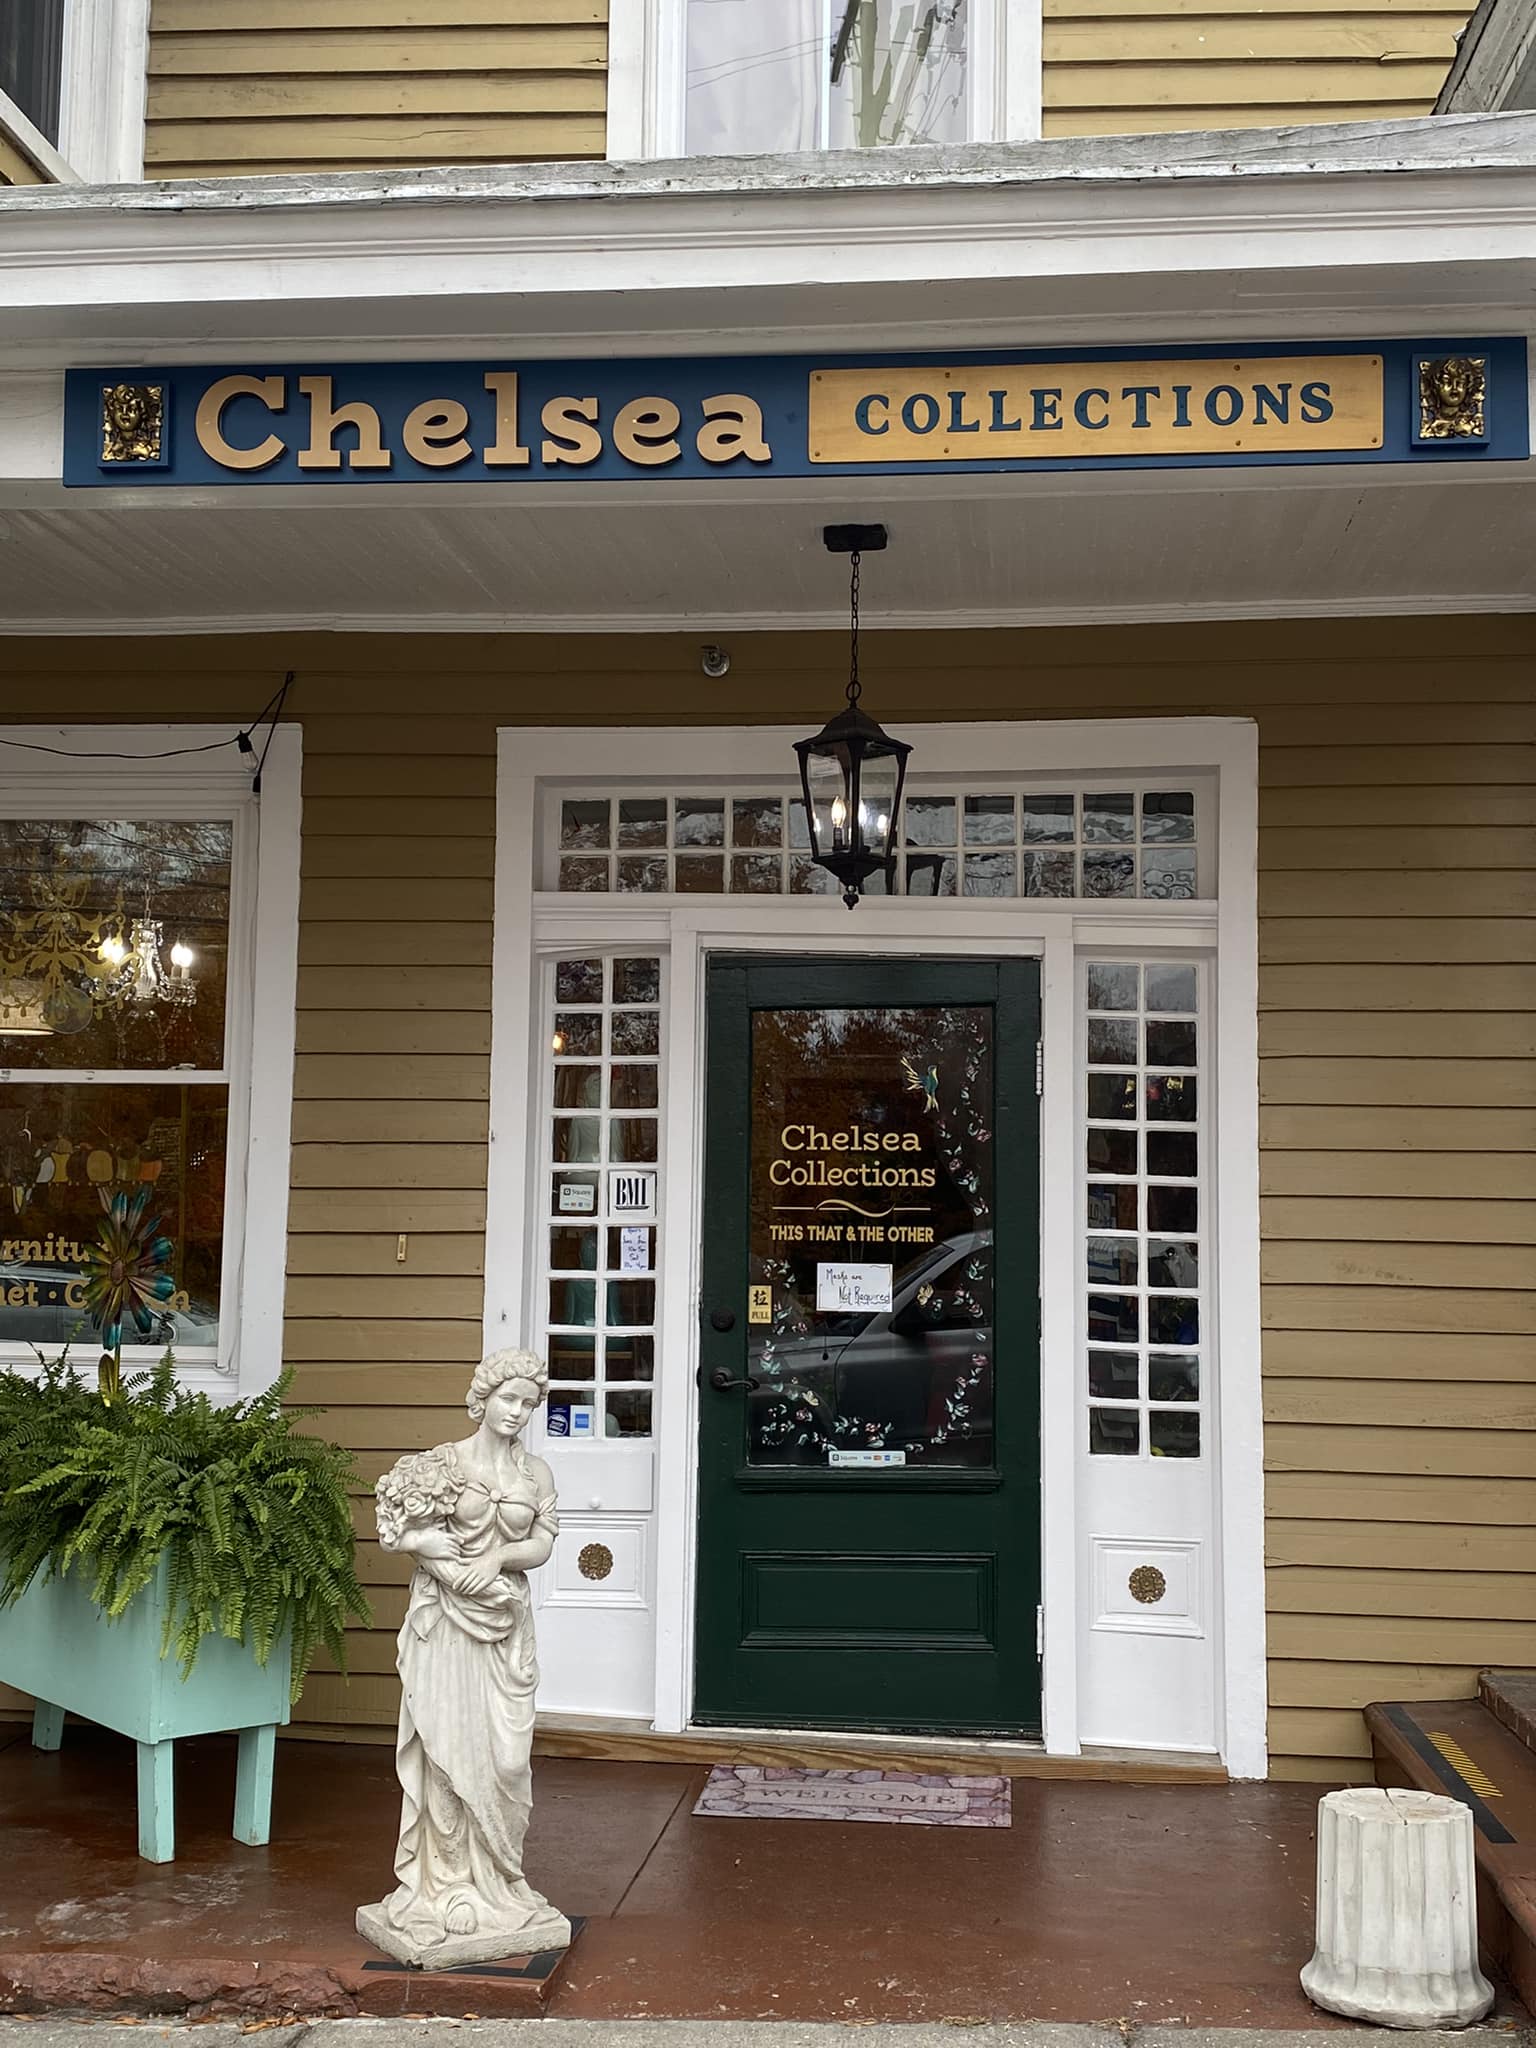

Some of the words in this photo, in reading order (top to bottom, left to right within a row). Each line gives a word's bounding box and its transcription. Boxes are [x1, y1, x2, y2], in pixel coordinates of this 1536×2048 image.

[194, 371, 773, 472] Chelsea
[853, 381, 1334, 435] COLLECTIONS
[781, 1125, 921, 1152] Chelsea
[769, 1160, 936, 1187] Collections
[616, 1177, 646, 1205] BMI
[769, 1225, 803, 1241] THIS
[807, 1225, 843, 1241] THAT
[846, 1226, 857, 1241] &
[858, 1226, 884, 1242] THE
[888, 1226, 934, 1242] OTHER
[753, 1290, 768, 1305] 拉
[839, 1285, 852, 1305] Not
[759, 1789, 957, 1805] WELCOME
